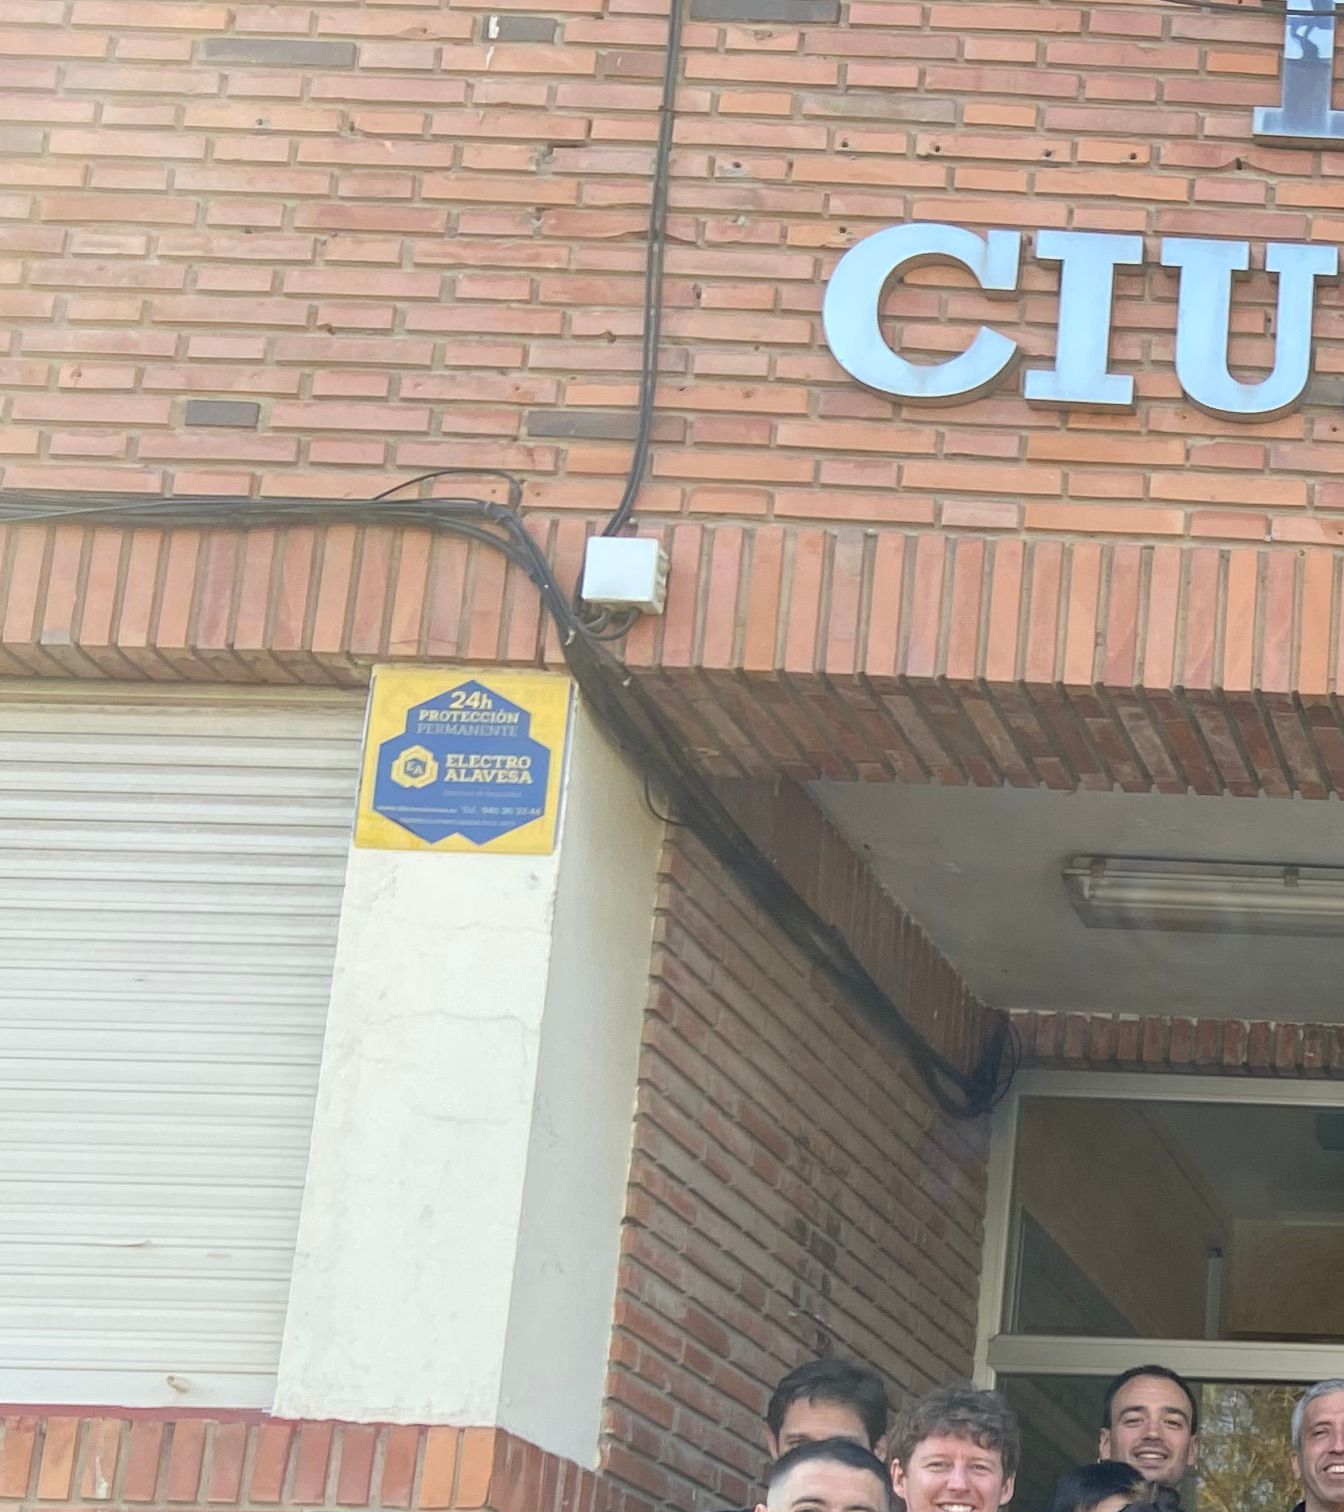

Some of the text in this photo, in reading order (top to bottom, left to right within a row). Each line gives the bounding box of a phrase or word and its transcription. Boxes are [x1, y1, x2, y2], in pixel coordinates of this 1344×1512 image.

[450, 691, 492, 709] 24h
[417, 709, 520, 724] PROTECCIÓN
[416, 723, 518, 738] PERMANENTE
[445, 754, 532, 768] ELECTRO
[444, 769, 533, 784] ALAVESA
